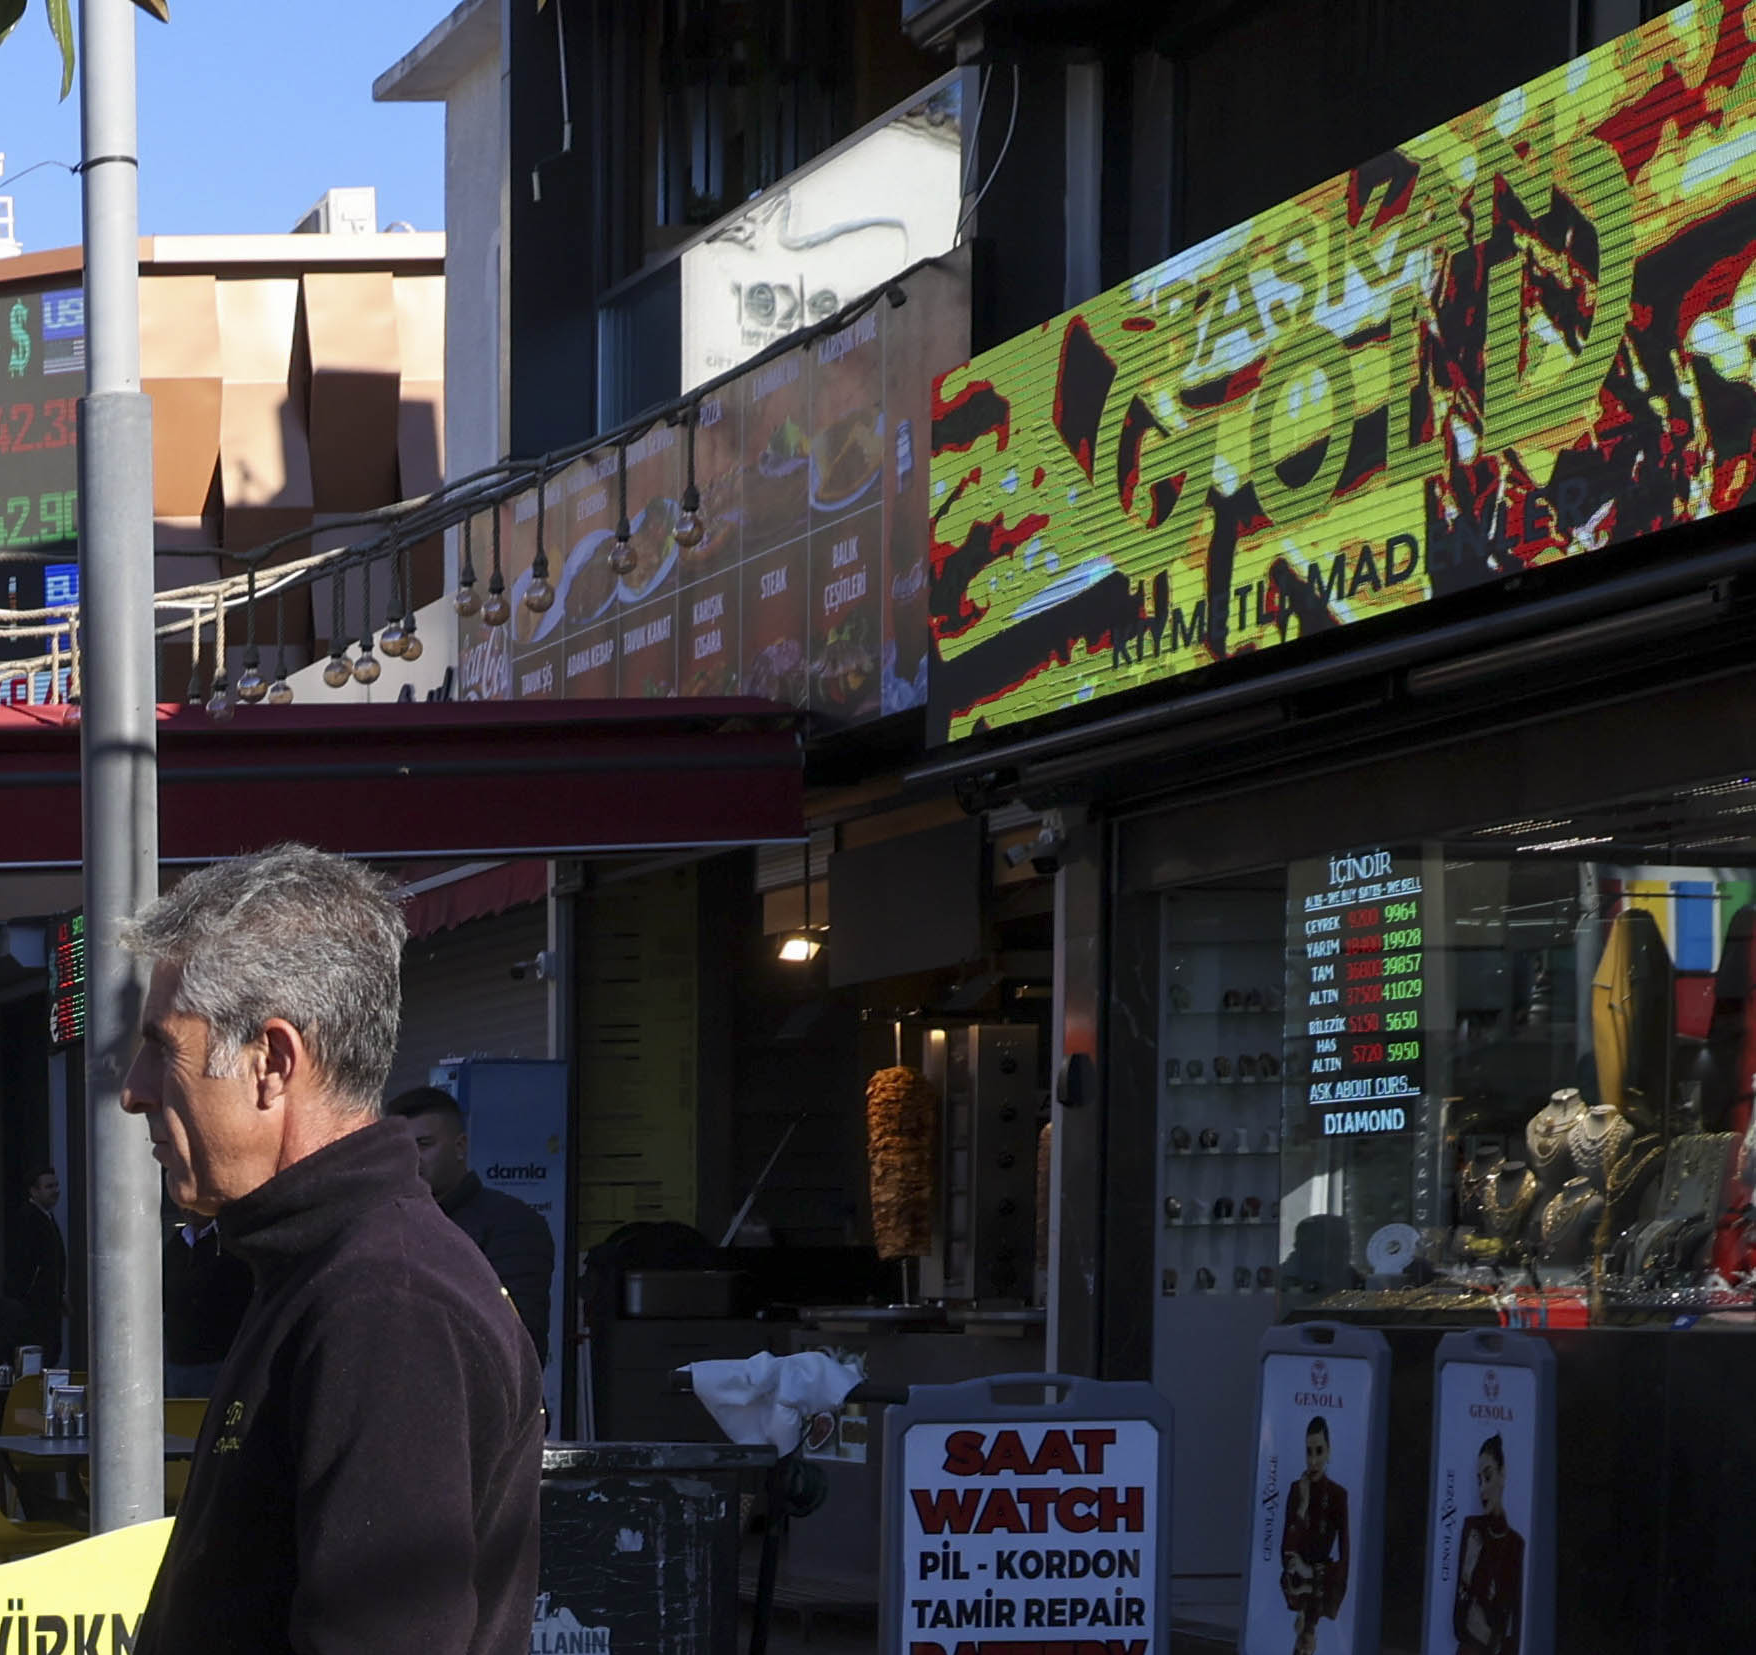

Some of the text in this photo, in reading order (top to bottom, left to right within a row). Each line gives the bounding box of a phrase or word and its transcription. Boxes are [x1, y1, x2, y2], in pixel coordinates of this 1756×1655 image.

[760, 566, 788, 600] STEAK
[1384, 901, 1417, 923] 9964
[1307, 938, 1340, 959] YARIM
[1382, 928, 1422, 950] 19928
[1311, 964, 1335, 983] TAM
[1382, 953, 1423, 976] 39857
[1309, 988, 1339, 1006] ALTIN
[1382, 979, 1423, 1000] 41029
[1386, 1010, 1418, 1032] 5650
[1316, 1038, 1337, 1053] HAS
[1387, 1041, 1420, 1061] 5950
[1311, 1057, 1342, 1073] ALTIN
[1310, 1082, 1332, 1101] ASK
[1334, 1079, 1372, 1098] ABOUT
[1324, 1108, 1405, 1135] DIAMOND
[486, 1161, 547, 1180] damla
[1294, 1391, 1344, 1409] GENOLA
[1469, 1404, 1514, 1422] GENOLA
[942, 1429, 1117, 1476] SAAT
[910, 1486, 1145, 1535] WATCH
[919, 1540, 970, 1580] PİL
[995, 1549, 1140, 1580] KORDON
[911, 1586, 1145, 1629] TAMİR REPAİR
